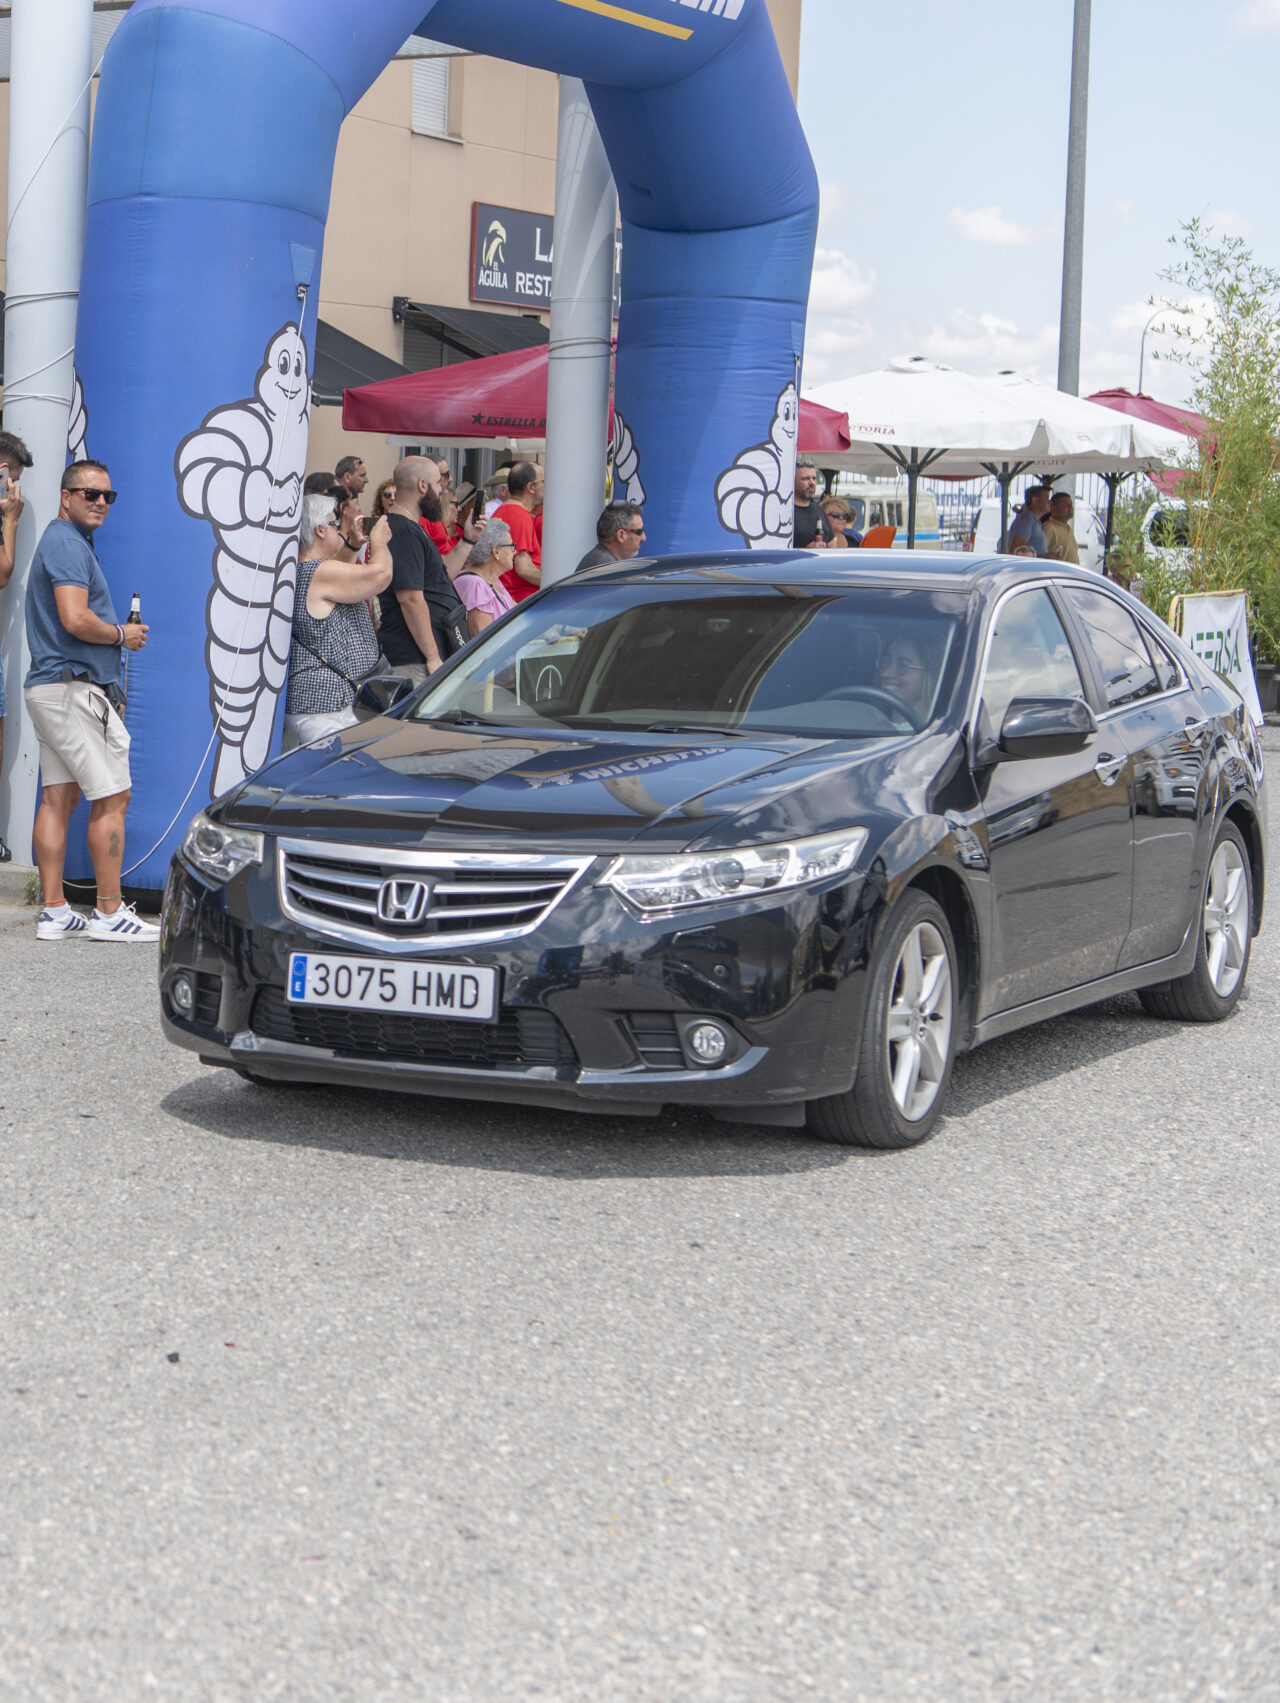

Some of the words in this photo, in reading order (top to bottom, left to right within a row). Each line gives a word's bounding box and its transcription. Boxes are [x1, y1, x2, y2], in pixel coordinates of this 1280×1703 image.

[535, 227, 554, 262] L
[515, 272, 552, 297] REST
[486, 416, 536, 428] ESTRELLA
[294, 980, 302, 992] E
[312, 963, 397, 1003] 3075
[412, 970, 480, 1010] HMD
